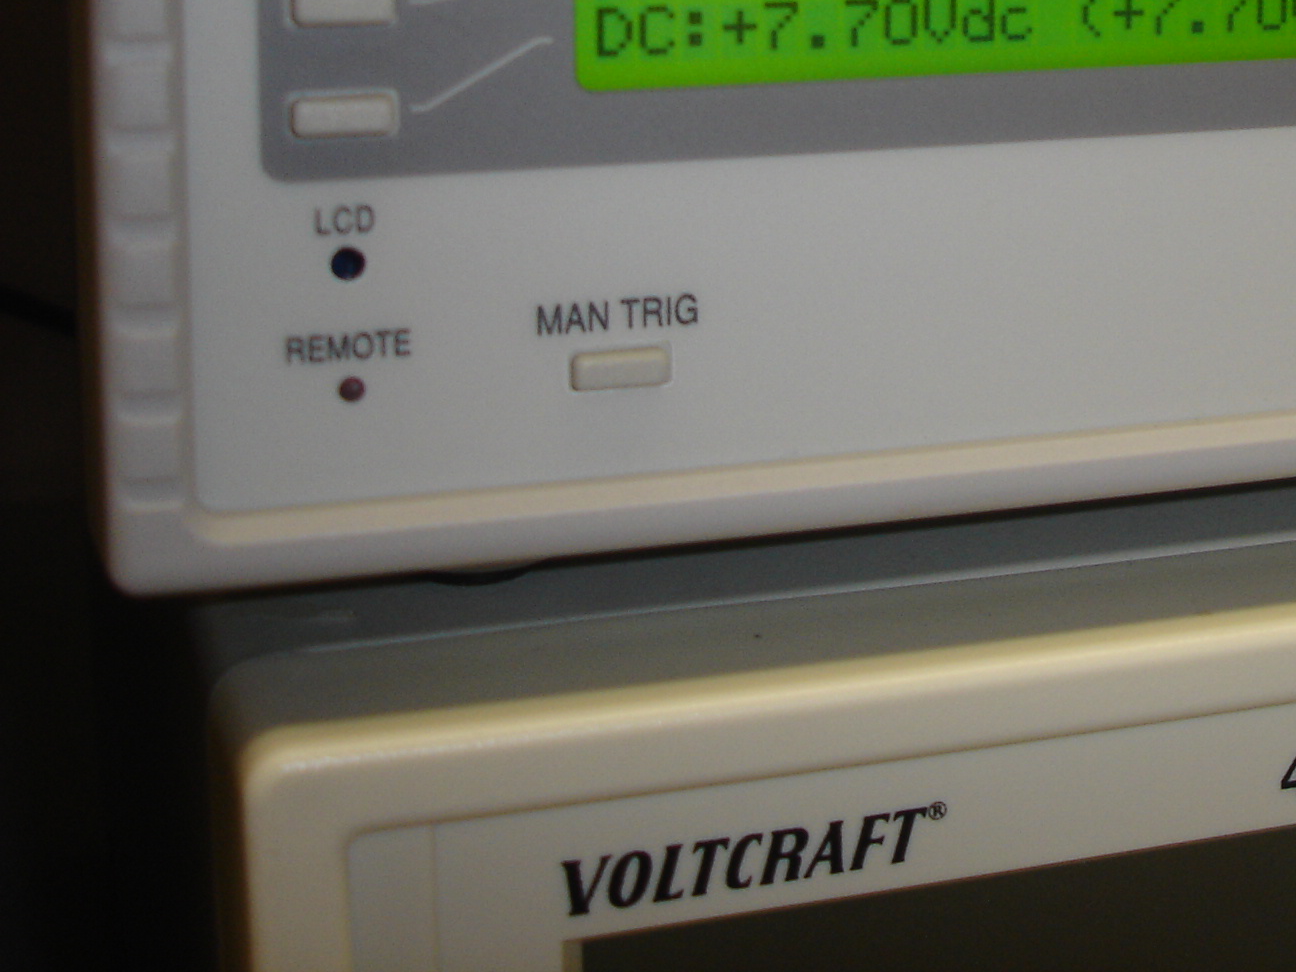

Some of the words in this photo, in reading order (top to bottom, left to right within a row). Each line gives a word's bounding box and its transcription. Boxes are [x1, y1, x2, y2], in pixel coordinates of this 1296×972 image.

[314, 204, 374, 236] LCD
[537, 302, 609, 336] MAN
[621, 293, 699, 329] TRIG
[285, 330, 411, 365] REMOTE
